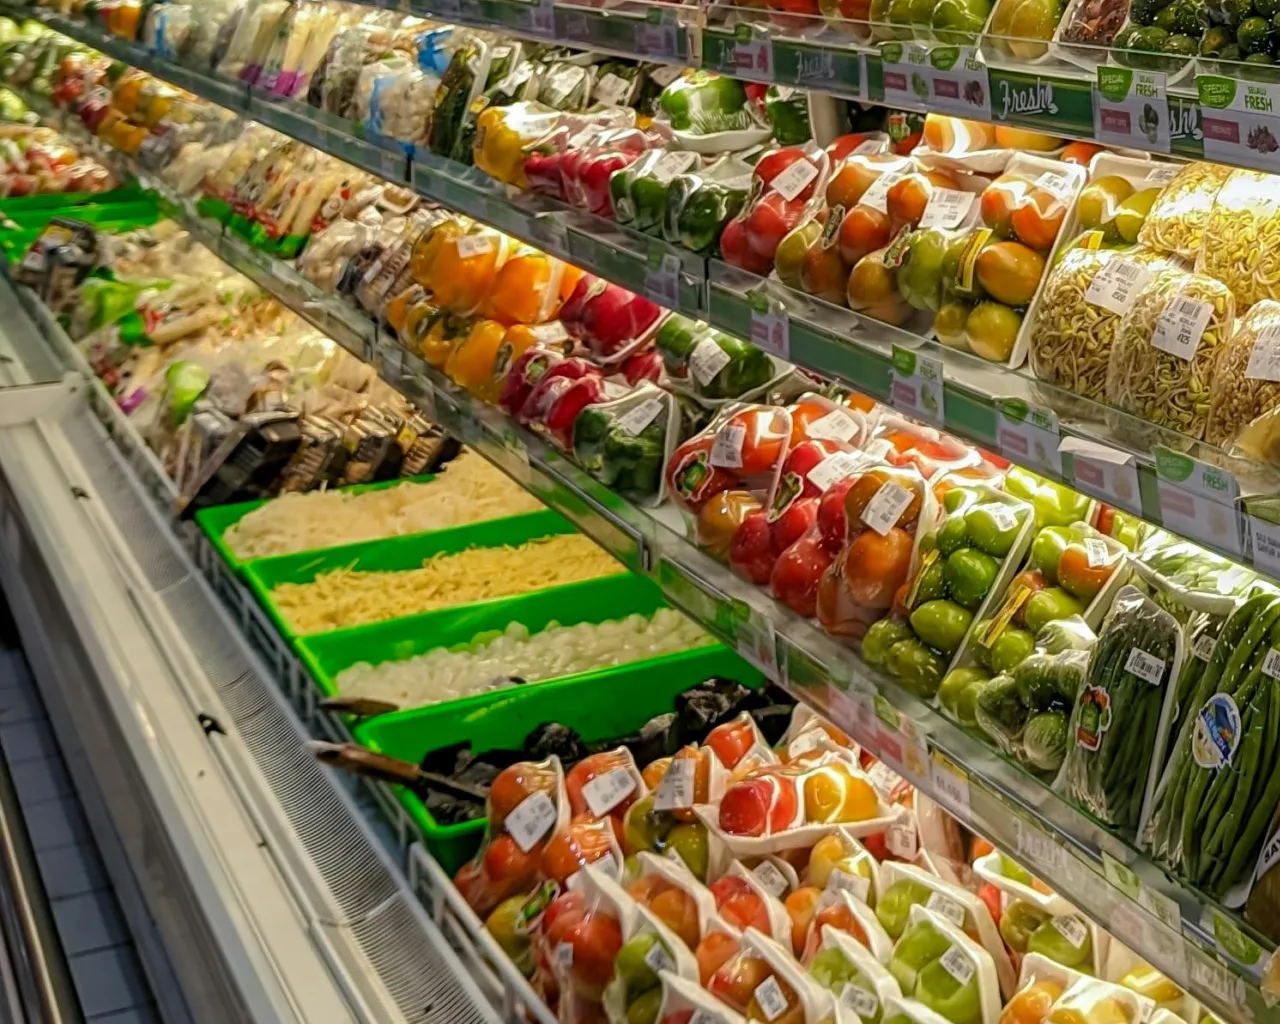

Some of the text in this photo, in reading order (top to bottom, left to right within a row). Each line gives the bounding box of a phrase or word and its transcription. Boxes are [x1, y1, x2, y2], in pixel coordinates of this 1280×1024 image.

[999, 77, 1046, 120] Fresh
[1135, 83, 1158, 98] FRESH
[1244, 95, 1273, 112] FRESH
